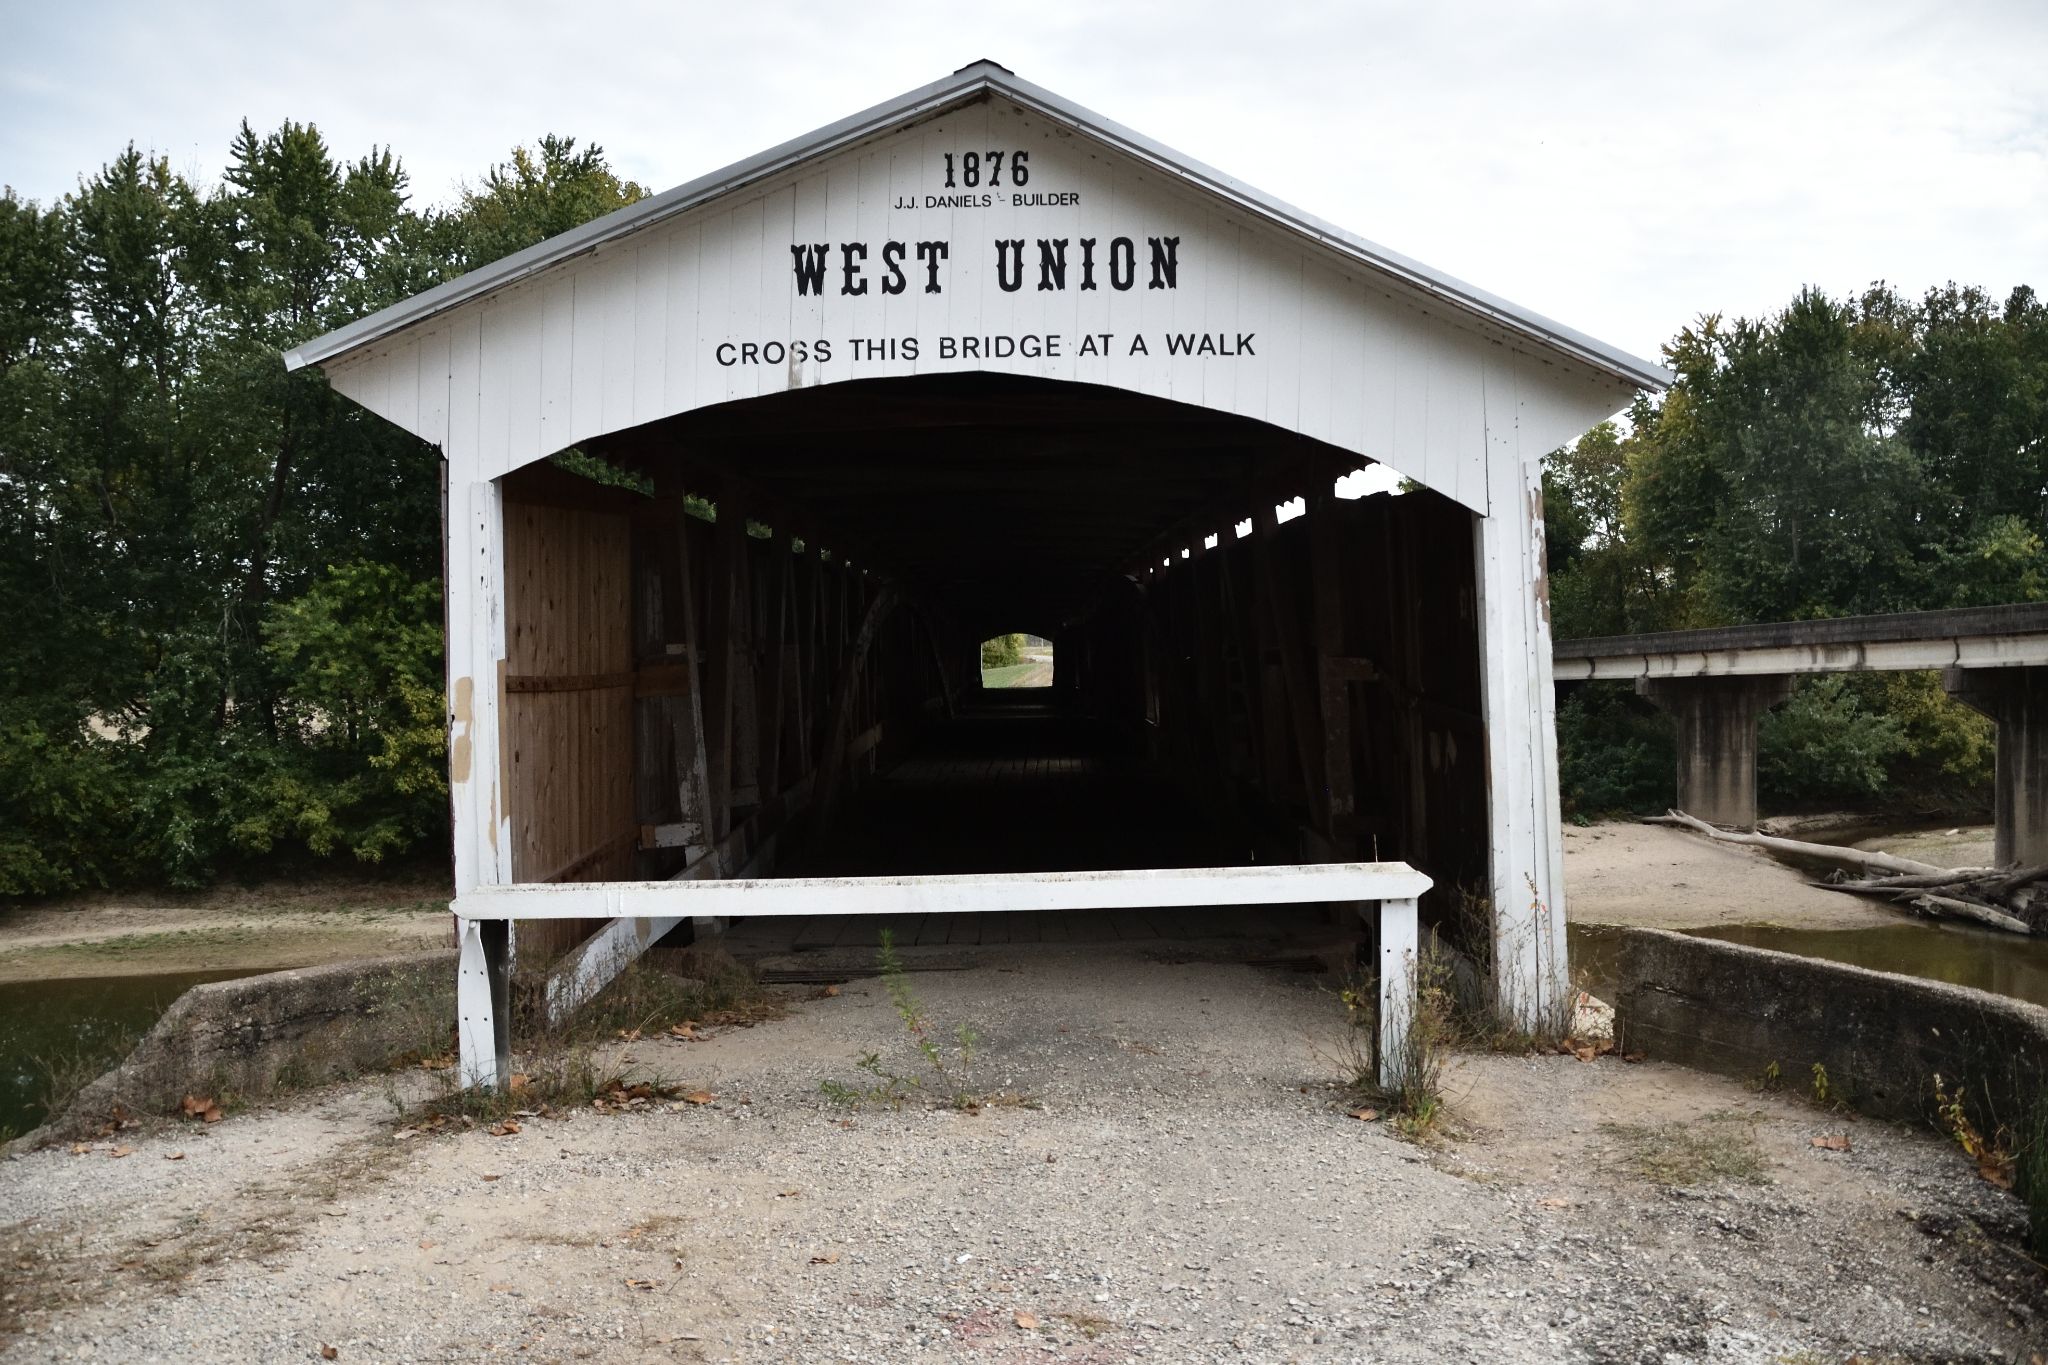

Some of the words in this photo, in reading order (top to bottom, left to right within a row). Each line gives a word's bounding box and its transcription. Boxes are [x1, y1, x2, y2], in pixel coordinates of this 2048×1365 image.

[943, 150, 1029, 189] 1876
[894, 196, 919, 210] J.J.
[925, 194, 992, 209] DANIELS
[1012, 192, 1080, 207] BUILDER
[790, 241, 949, 297] WEST
[994, 235, 1181, 293] UNION
[716, 339, 832, 367] CROSS
[848, 337, 920, 361] THIS
[939, 334, 1061, 359] BRIDGE
[1079, 334, 1114, 357] AT
[1129, 334, 1149, 356] A
[1165, 333, 1256, 356] WALK
